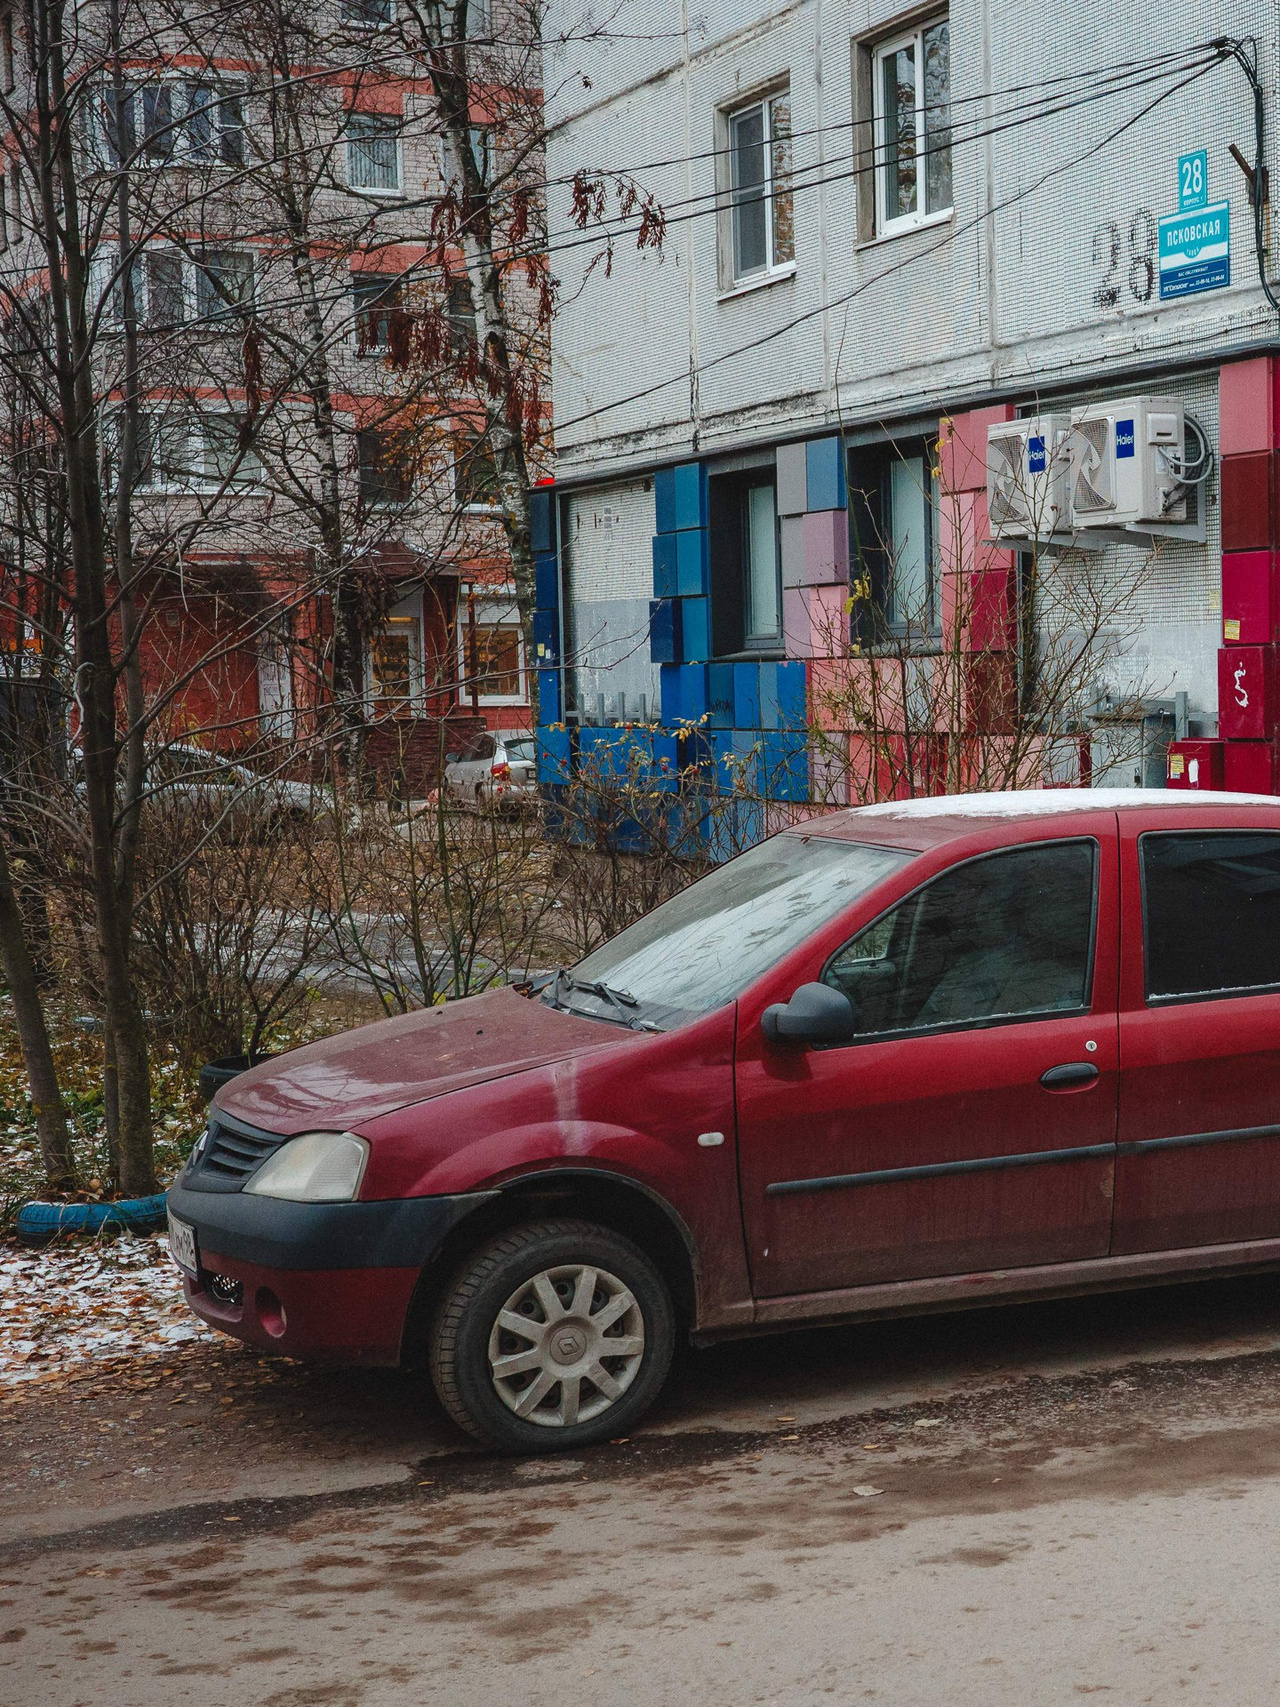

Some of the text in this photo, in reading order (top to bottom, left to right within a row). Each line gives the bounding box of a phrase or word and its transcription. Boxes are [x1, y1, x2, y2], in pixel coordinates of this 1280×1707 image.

[1182, 158, 1203, 197] 28
[1167, 219, 1220, 247] ПСКОВСКАЯ
[1116, 433, 1134, 446] Haier
[1029, 449, 1045, 461] Haier
